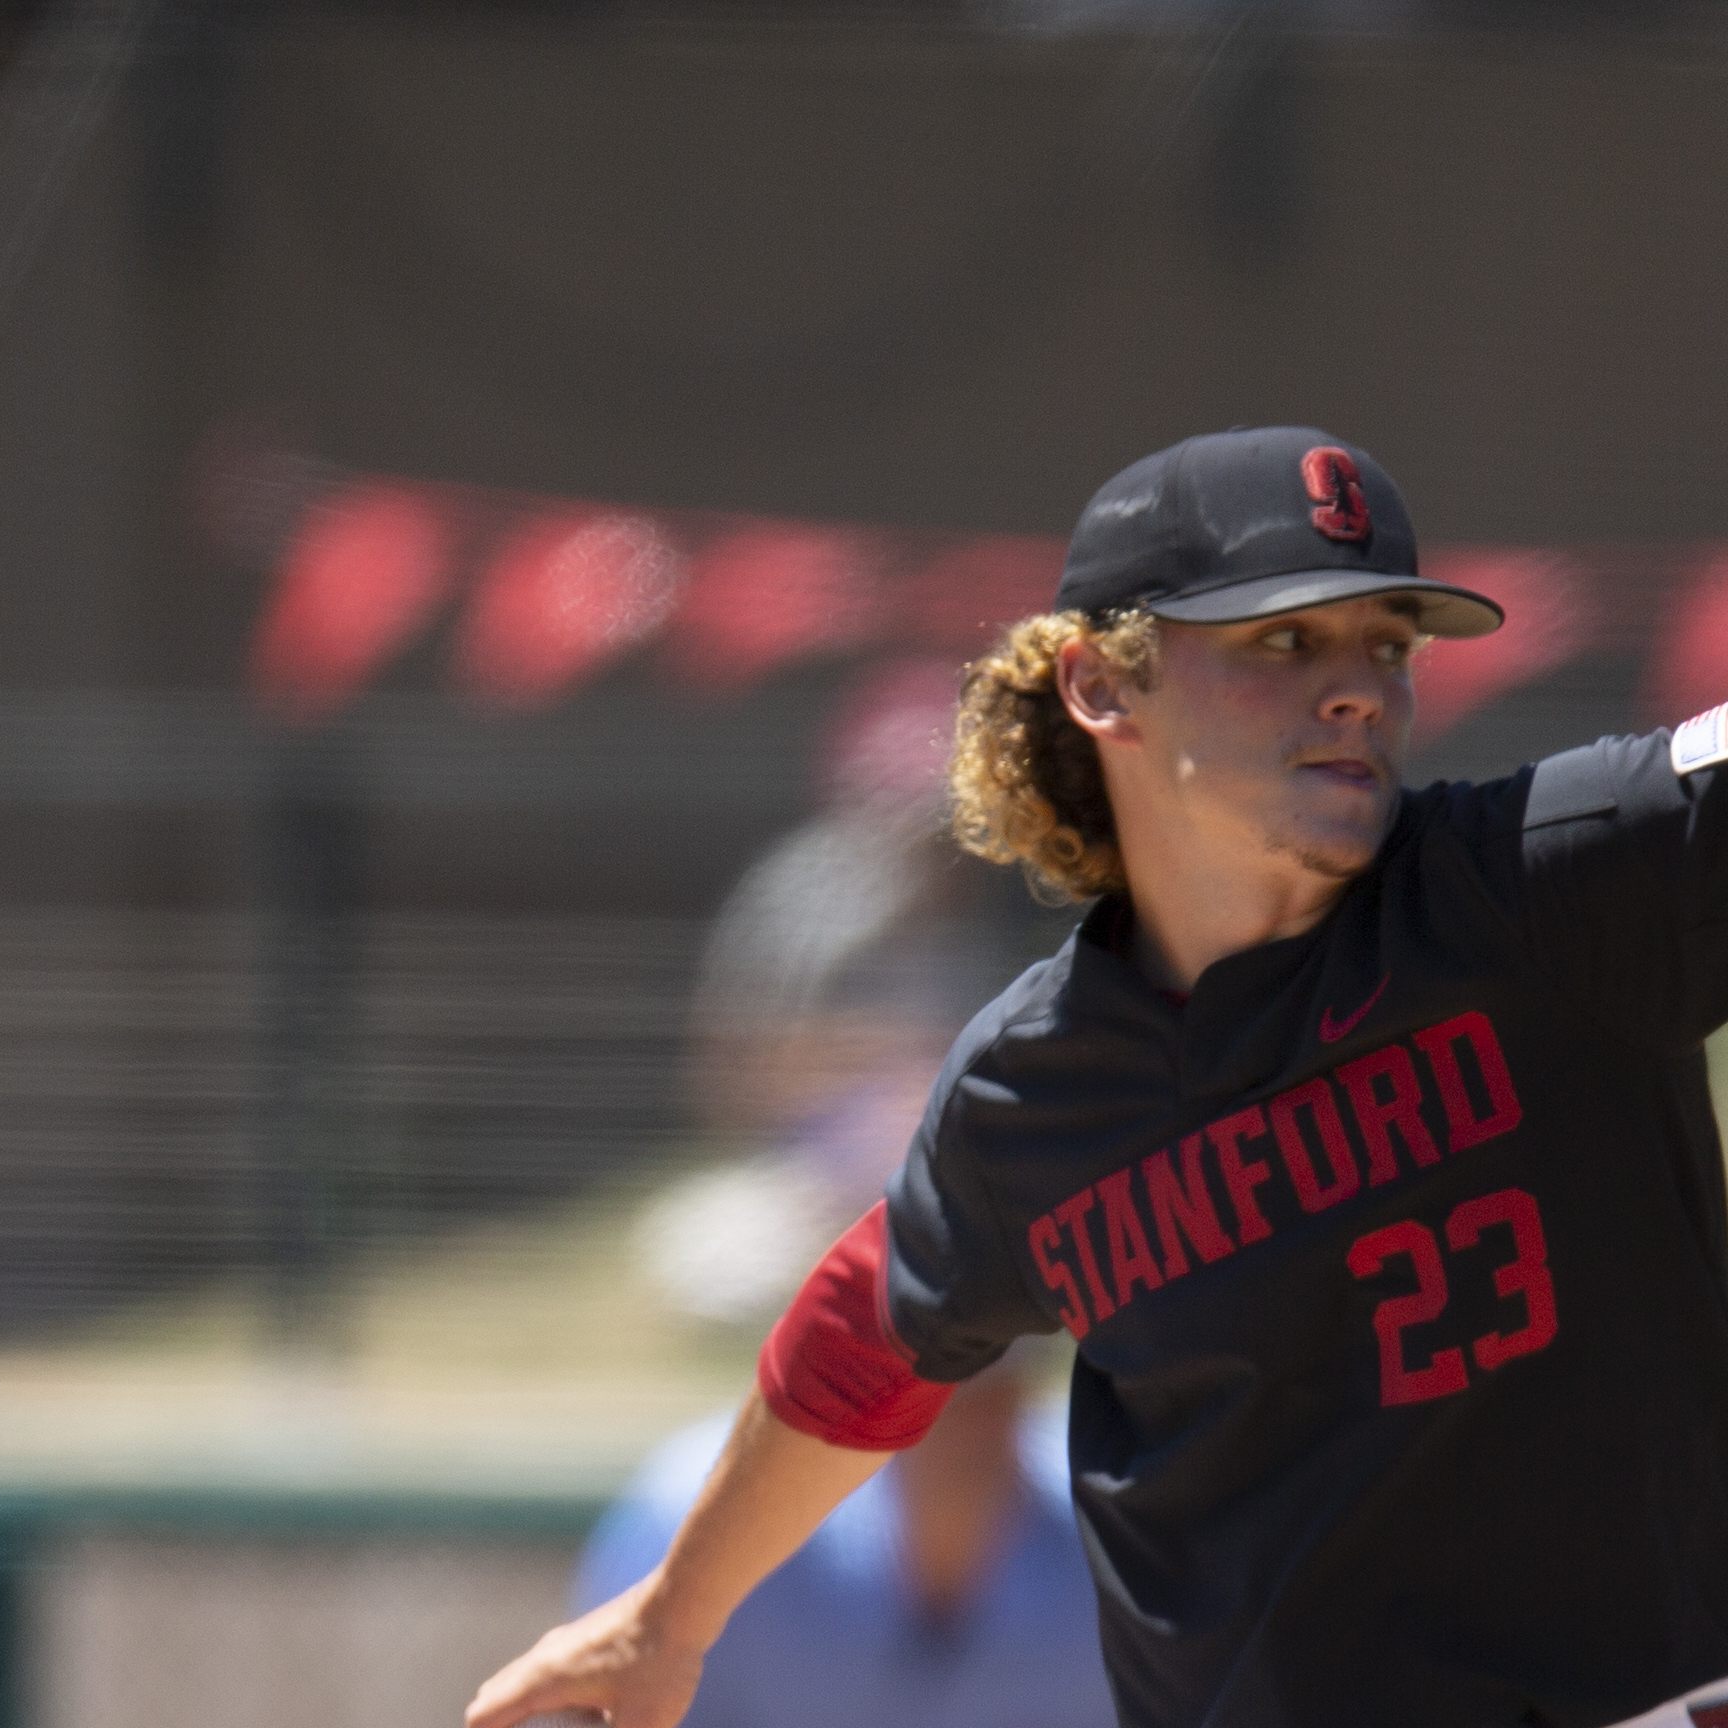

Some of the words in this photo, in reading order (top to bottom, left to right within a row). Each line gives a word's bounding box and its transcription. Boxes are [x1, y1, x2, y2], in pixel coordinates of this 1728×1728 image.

[1301, 446, 1371, 541] S
[1026, 1010, 1523, 1341] STANFORD
[1347, 1187, 1558, 1406] 23
